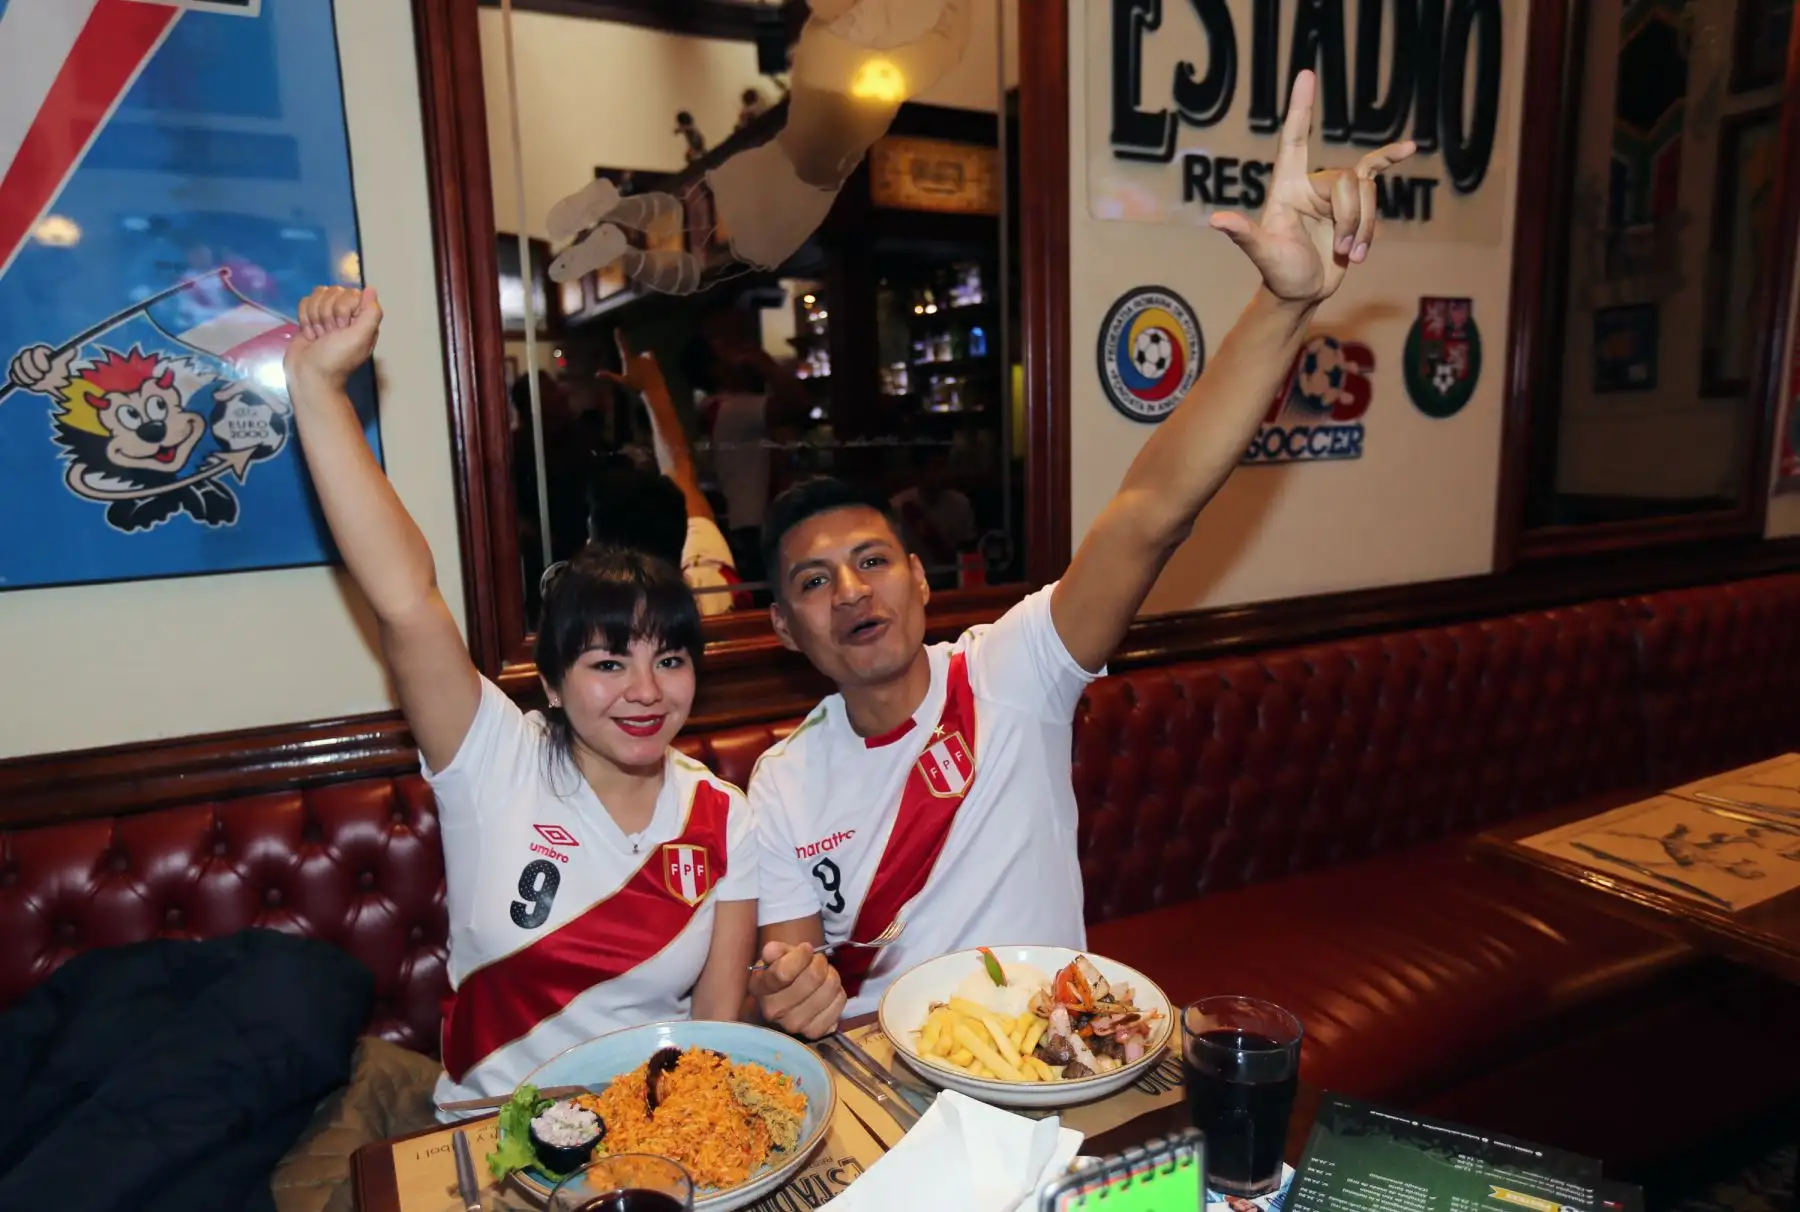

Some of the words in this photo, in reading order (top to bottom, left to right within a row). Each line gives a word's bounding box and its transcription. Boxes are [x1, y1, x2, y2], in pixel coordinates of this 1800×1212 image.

[228, 419, 268, 430] EURO
[230, 430, 270, 440] 2000
[1243, 424, 1364, 461] SOCCER
[529, 842, 570, 864] umbro
[509, 859, 561, 930] 9
[811, 856, 846, 914] 9
